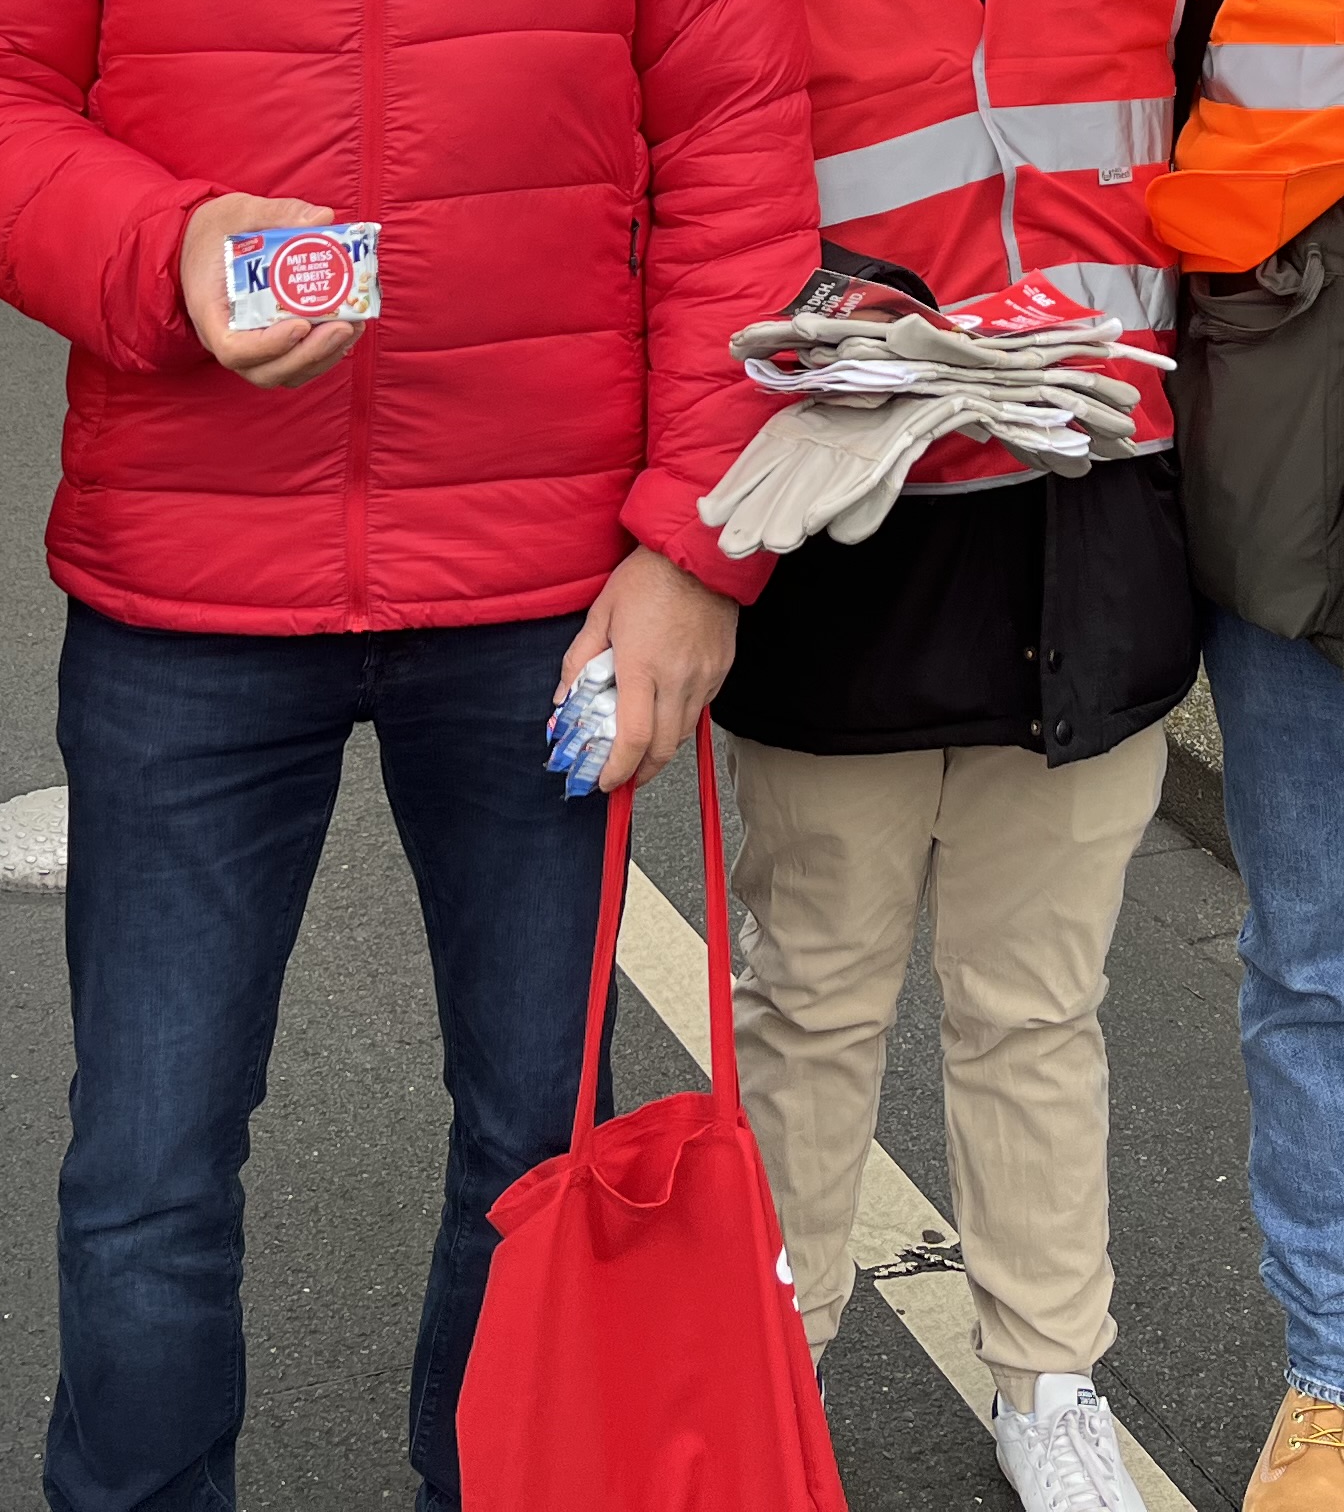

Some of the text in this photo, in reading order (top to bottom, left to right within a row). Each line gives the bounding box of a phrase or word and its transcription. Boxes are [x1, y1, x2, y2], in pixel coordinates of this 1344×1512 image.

[287, 253, 308, 266] MIT
[309, 250, 333, 263] BISS
[288, 269, 336, 284] ARBEITS-
[806, 282, 836, 307] DICH.
[835, 292, 866, 319] LAND.
